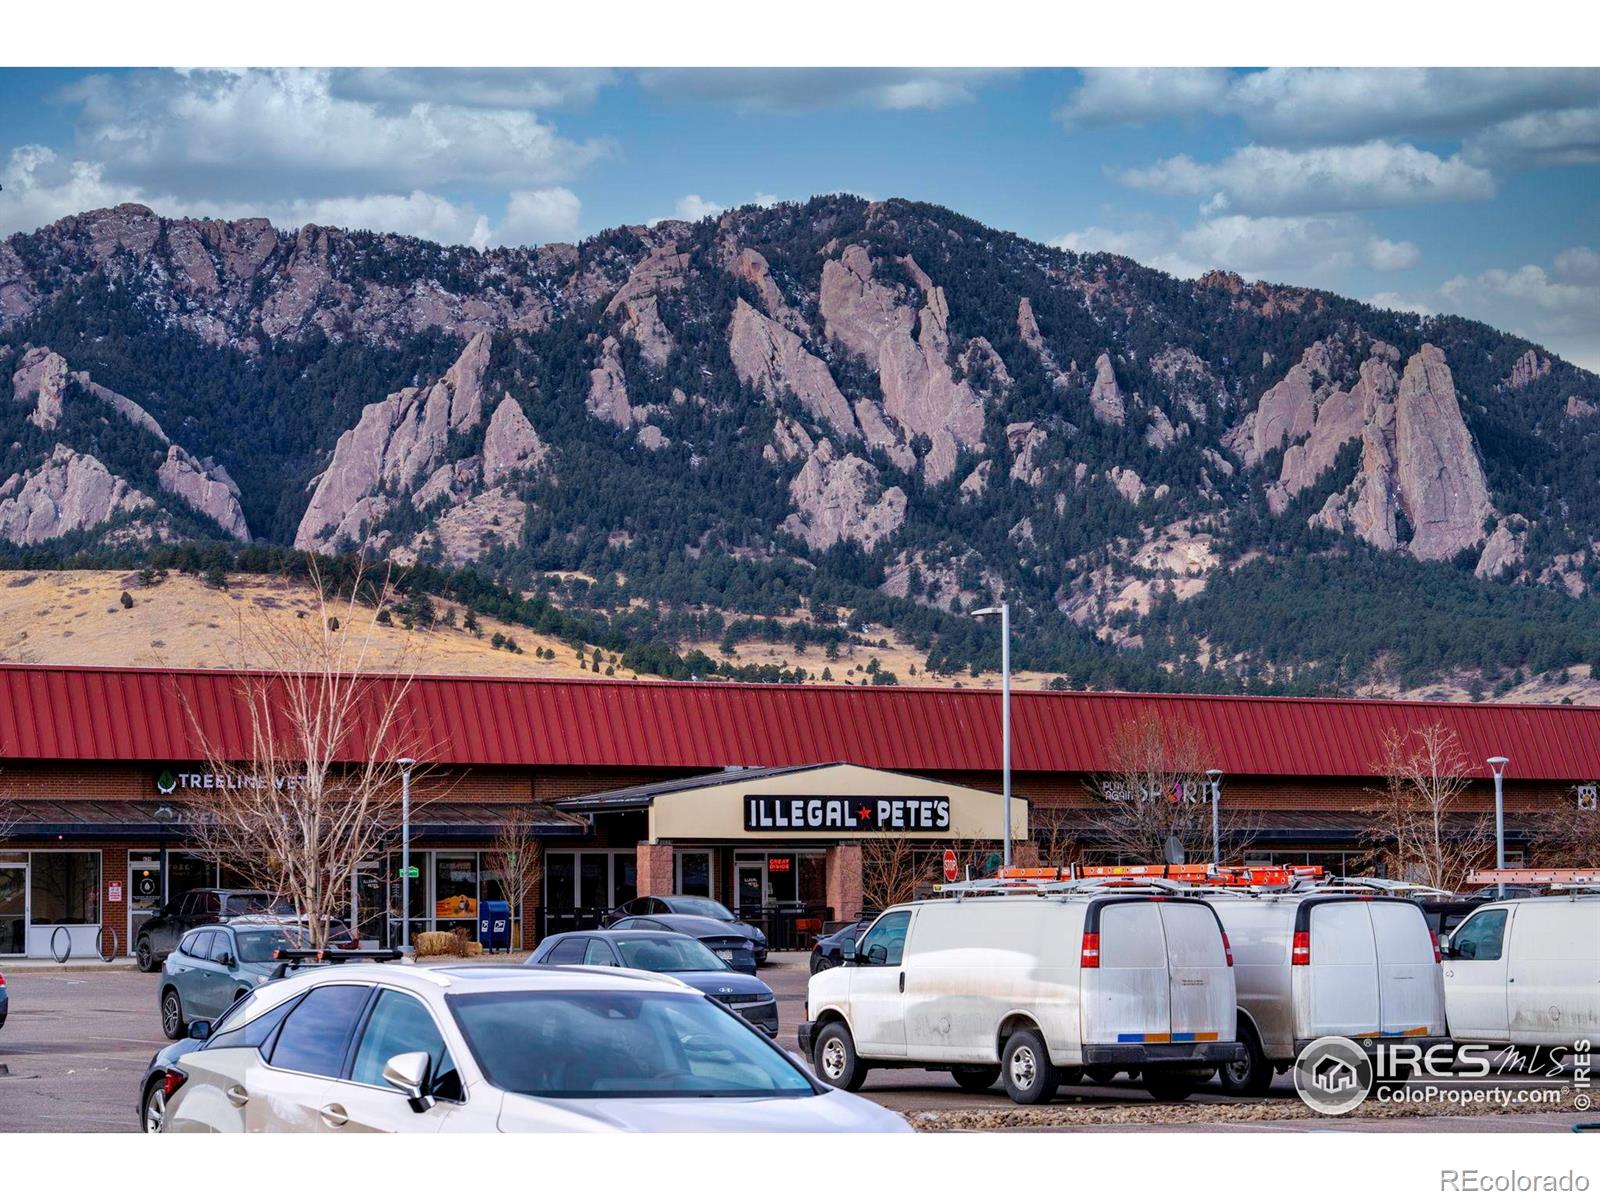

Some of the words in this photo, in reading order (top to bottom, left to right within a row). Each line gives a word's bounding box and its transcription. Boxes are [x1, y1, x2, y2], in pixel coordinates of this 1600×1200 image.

[178, 774, 268, 789] TREELINE
[1104, 790, 1134, 801] AGAIN
[1140, 781, 1221, 804] SPORT
[750, 799, 858, 827] ILLEGAL
[877, 800, 949, 828] PETE'S
[944, 859, 957, 871] STOP
